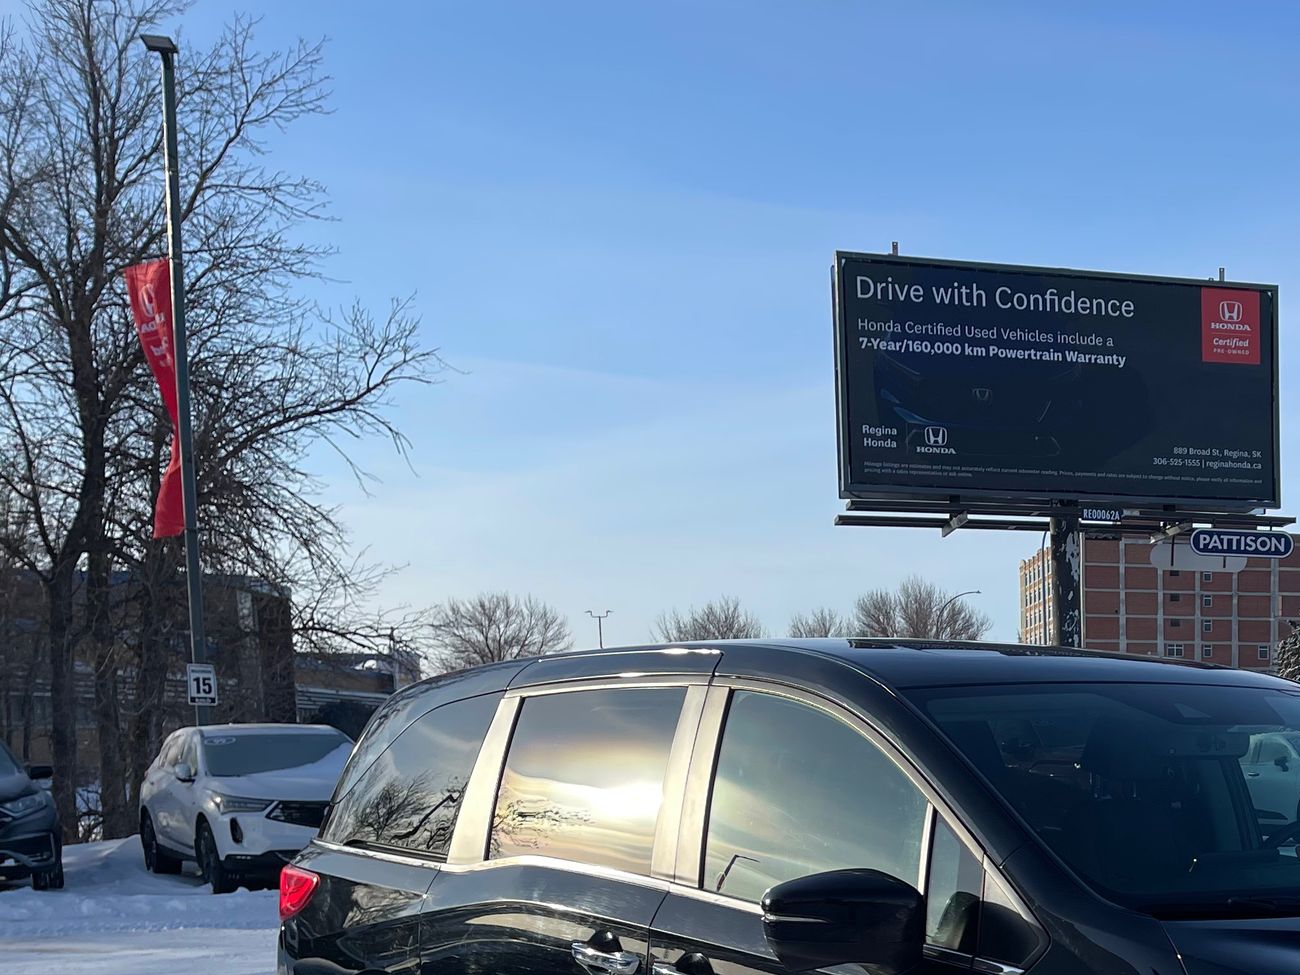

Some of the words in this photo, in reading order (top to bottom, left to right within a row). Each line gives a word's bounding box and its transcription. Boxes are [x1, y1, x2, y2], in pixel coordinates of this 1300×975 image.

[855, 274, 925, 303] Drive
[931, 283, 988, 309] with
[995, 285, 1136, 318] Confidence
[857, 317, 902, 333] Honda
[904, 320, 962, 337] Certified
[965, 324, 999, 339] Used
[1001, 327, 1054, 344] Vehicles
[1056, 330, 1103, 346] include
[1105, 336, 1115, 347] a
[1210, 322, 1252, 331] HONDA
[1213, 337, 1249, 348] Certified
[859, 335, 962, 356] 7-Year/160,000
[964, 342, 987, 357] km
[989, 344, 1063, 362] Powertrain
[1065, 349, 1127, 369] Warranty
[862, 424, 898, 437] Regina
[863, 437, 897, 448] Honda
[916, 446, 957, 454] HONDA
[1173, 446, 1188, 455] 889
[1189, 448, 1211, 456] Broad
[1252, 450, 1262, 458] SK
[1152, 457, 1201, 467] 306-525-1555
[1206, 460, 1262, 469] reginahonda.ca
[1083, 508, 1120, 520] RE00062A
[1199, 534, 1285, 552] PATTISON
[192, 676, 212, 694] 15
